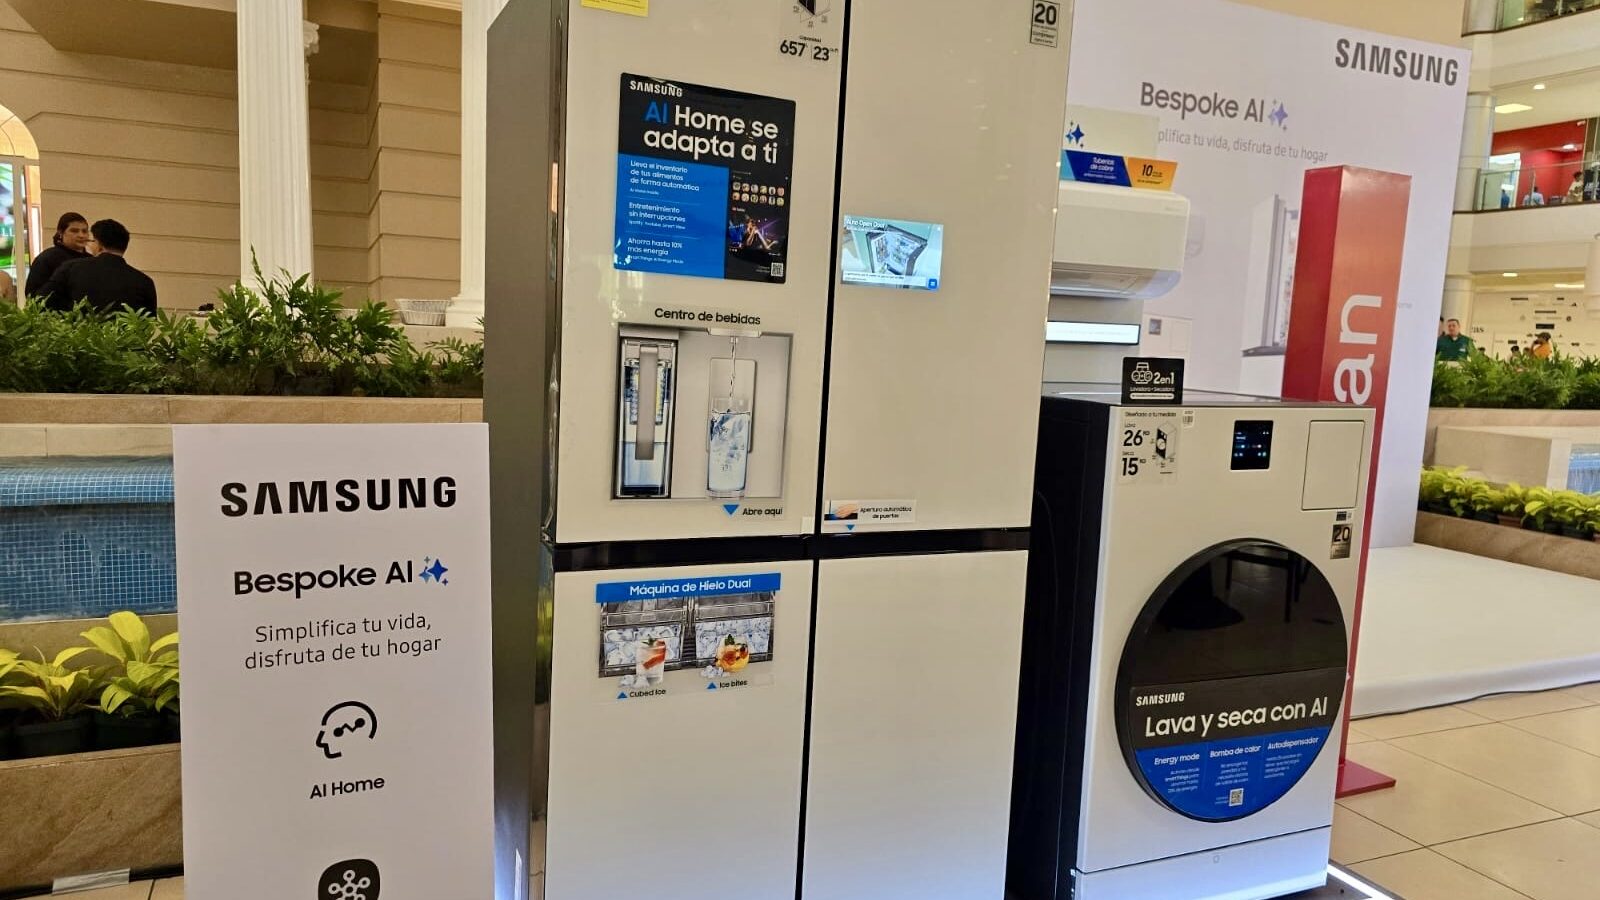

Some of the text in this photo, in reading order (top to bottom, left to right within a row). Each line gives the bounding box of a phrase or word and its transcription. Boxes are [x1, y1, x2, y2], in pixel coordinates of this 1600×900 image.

[1034, 3, 1057, 25] 20
[780, 40, 805, 56] 657
[813, 46, 830, 61] 23
[1334, 38, 1459, 86] SAMSUNG
[630, 80, 683, 98] SAMSUNG
[1140, 82, 1264, 123] Bespoke AI
[644, 101, 779, 140] AI Home se
[644, 129, 778, 165] adapta a ti
[1158, 128, 1191, 145] plifica
[1193, 132, 1204, 146] tu
[1233, 138, 1272, 157] disfruta
[1274, 141, 1288, 157] de
[1289, 144, 1299, 159] tu
[1301, 147, 1328, 164] hogar
[630, 160, 648, 168] Lleva
[656, 163, 688, 174] inventario
[1142, 164, 1153, 176] 10
[640, 178, 661, 187] forma
[652, 172, 683, 181] alimentos
[629, 202, 680, 213] Entretenimiento
[639, 211, 686, 222] interrupciones
[859, 220, 872, 228] Open
[628, 238, 650, 246] Ahorra
[652, 240, 670, 248] hasta
[654, 308, 761, 325] Centro de bebidas
[1153, 372, 1174, 385] 2en1
[1123, 430, 1143, 446] 26
[1122, 457, 1138, 476] 15
[220, 476, 457, 517] SAMSUNG
[742, 508, 763, 516] Abre
[1334, 526, 1350, 542] 20
[234, 560, 413, 599] Bespoke AI
[629, 578, 751, 597] Máquina de Hielo Dual
[255, 612, 432, 643] Simplifica tu vida,
[245, 636, 441, 670] disfruta de tu hogar
[719, 679, 747, 689] Ice bites
[629, 689, 653, 698] Cubed
[1136, 692, 1185, 707] SAMSUNG
[1145, 696, 1328, 737] Lava y seca con AI
[1154, 753, 1200, 766] Energy mode
[1210, 749, 1234, 758] Bomba
[310, 776, 385, 799] AI Home
